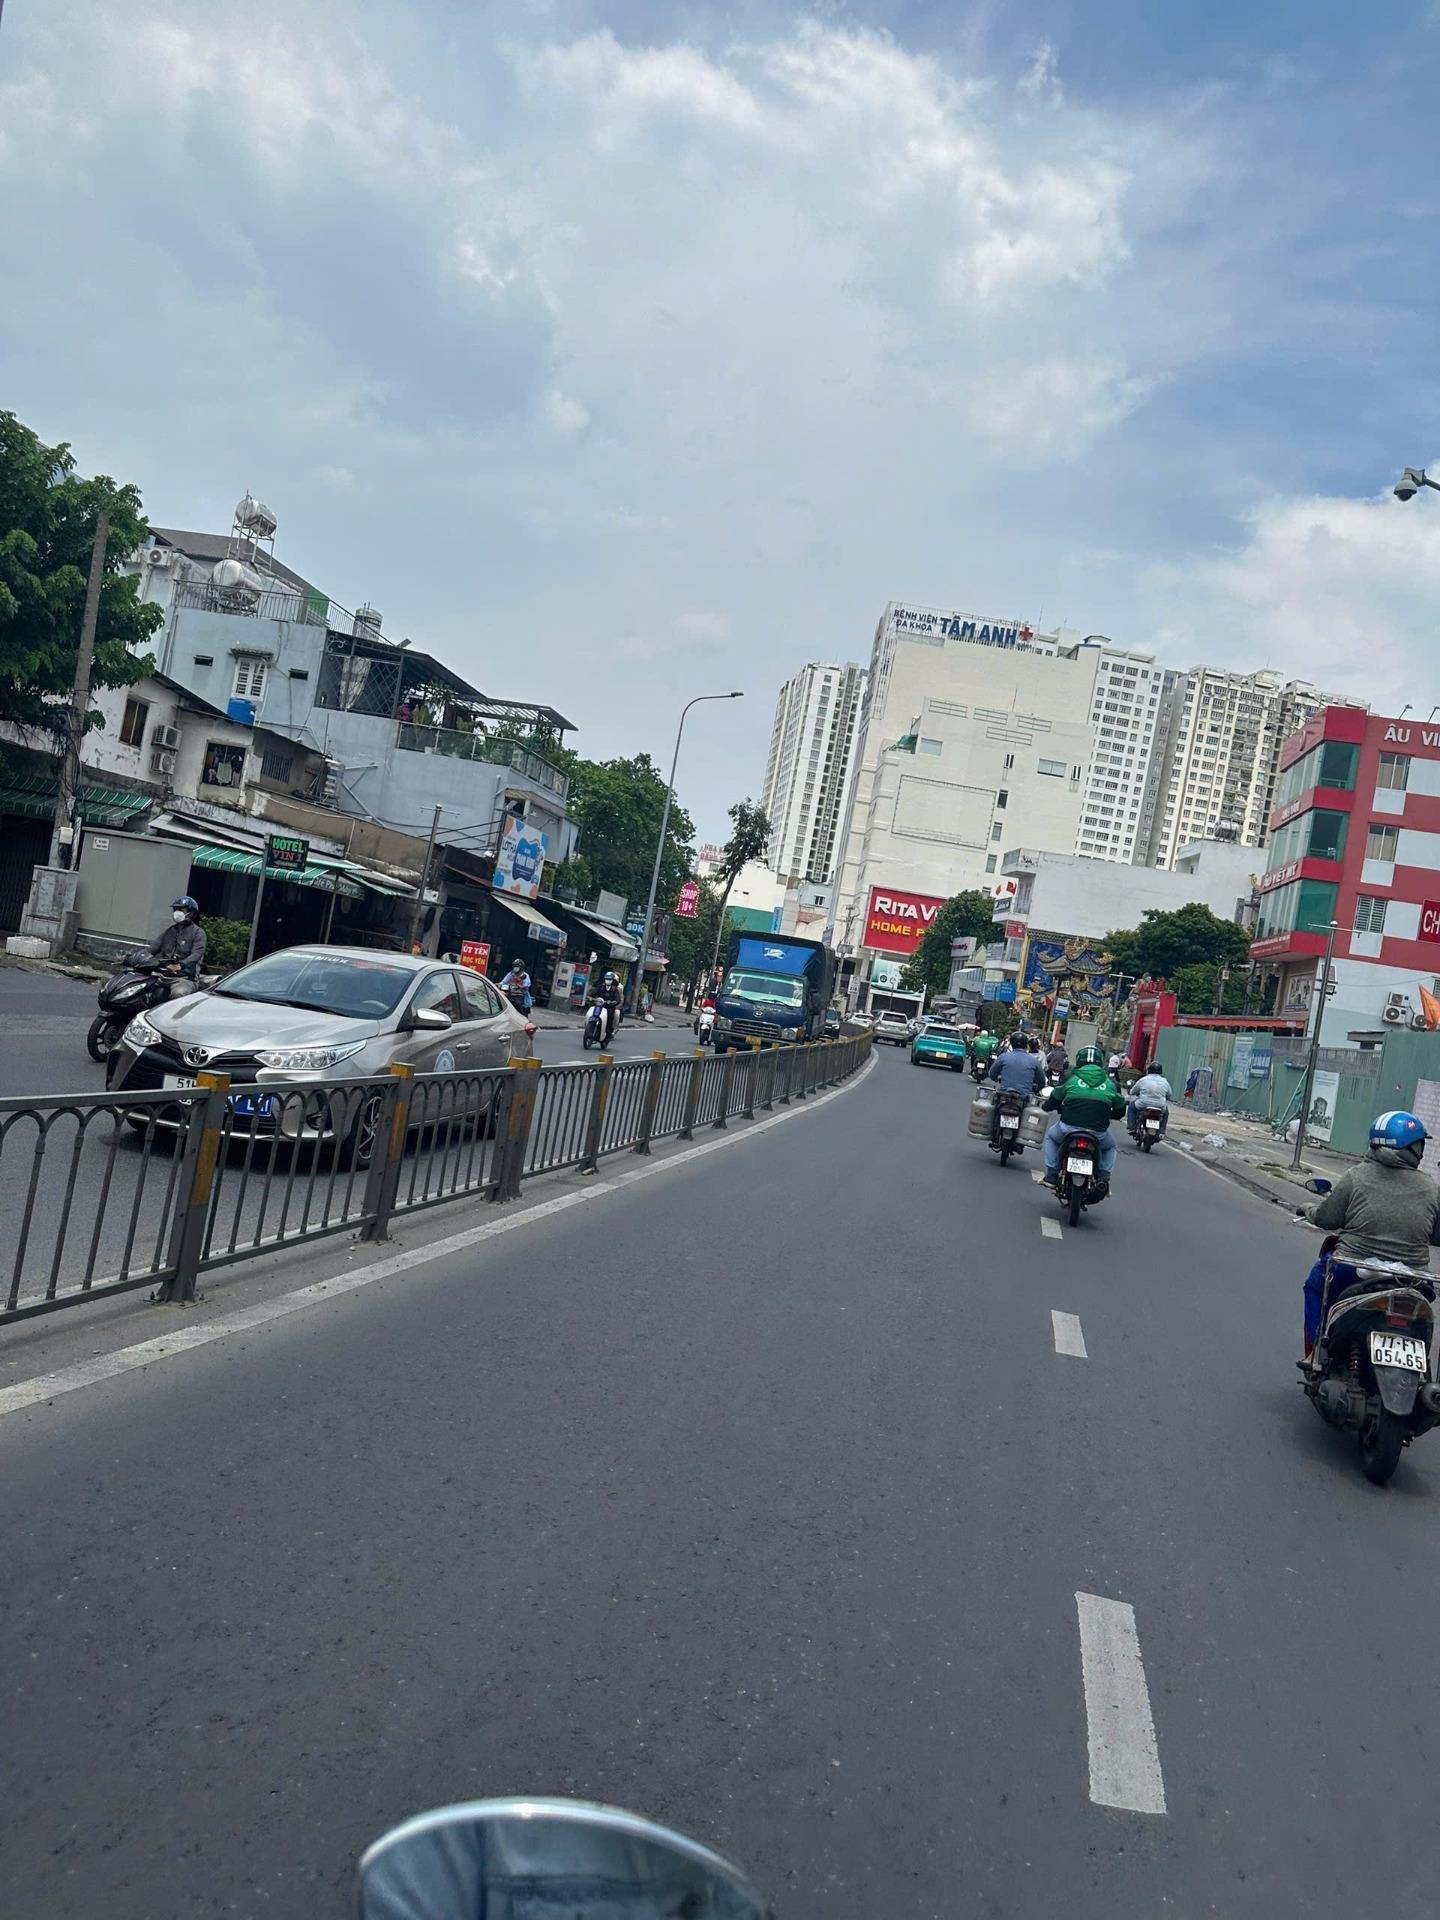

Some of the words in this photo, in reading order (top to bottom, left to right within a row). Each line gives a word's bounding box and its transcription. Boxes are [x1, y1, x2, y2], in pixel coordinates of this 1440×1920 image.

[896, 620, 907, 629] ĐA
[910, 621, 932, 632] KHOA
[940, 615, 976, 638] TÂM
[979, 624, 1017, 645] ANH
[1384, 723, 1410, 743] ÂU
[1421, 730, 1440, 748] VI
[272, 838, 304, 853] HOTEL
[681, 888, 698, 900] SHOP
[682, 900, 693, 912] 18+
[874, 896, 918, 919] RITA
[871, 920, 911, 936] HOME
[916, 928, 926, 938] P
[463, 943, 473, 953] ÚT
[1375, 1348, 1423, 1370] 054.65
